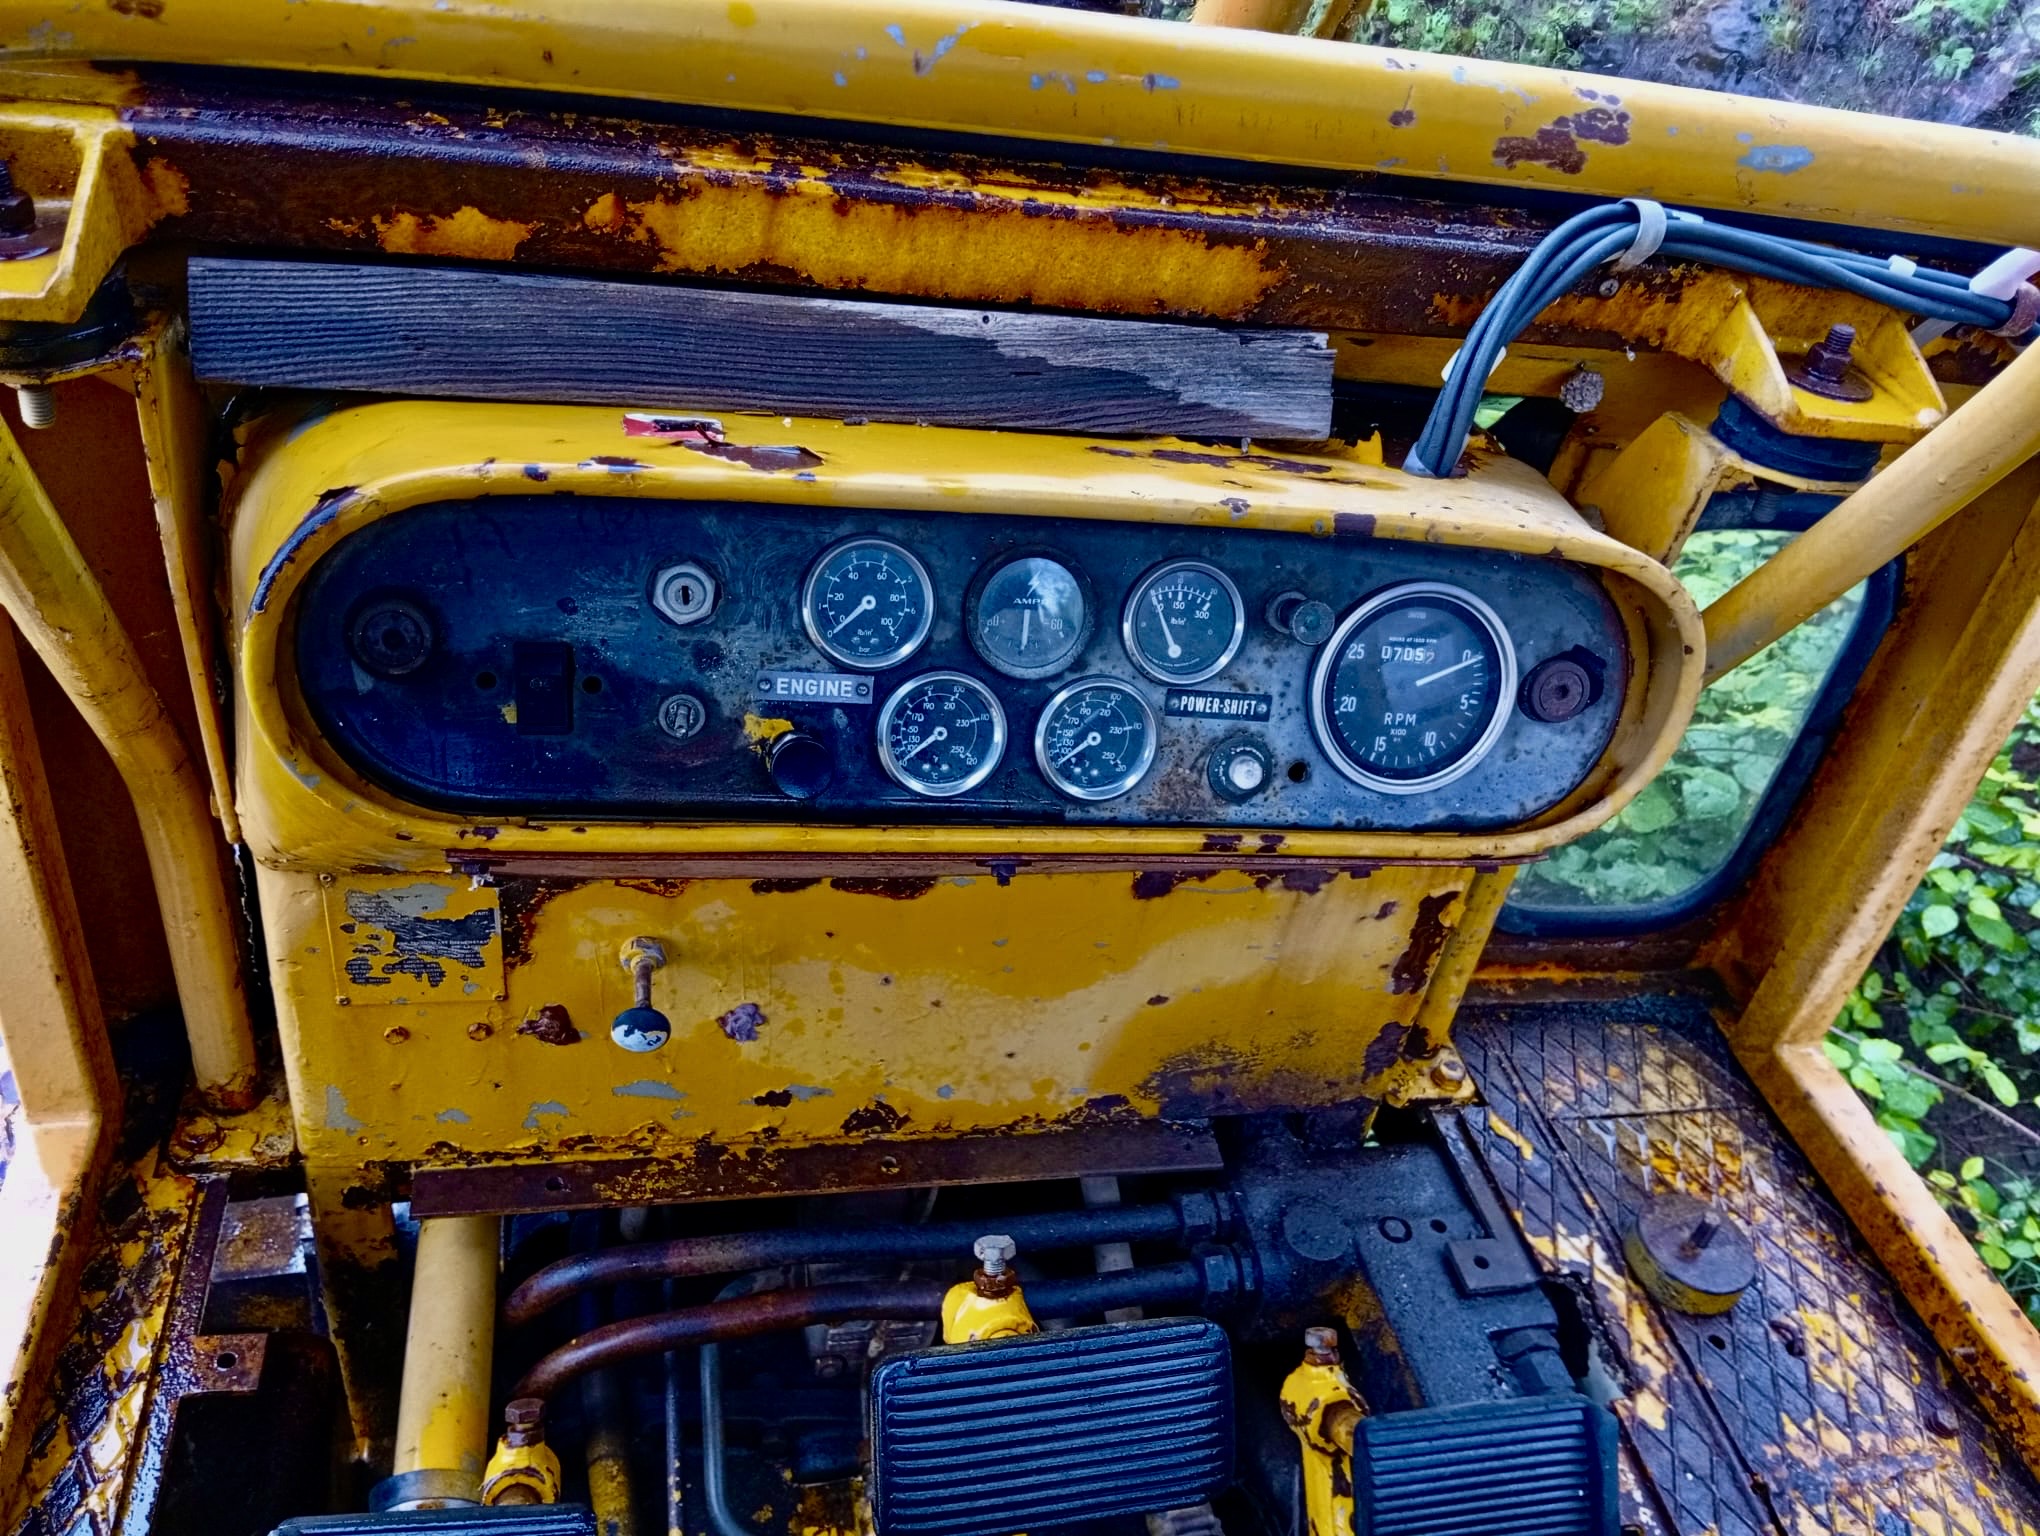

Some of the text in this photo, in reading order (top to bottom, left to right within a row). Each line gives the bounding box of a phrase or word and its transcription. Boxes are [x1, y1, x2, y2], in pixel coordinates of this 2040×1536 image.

[848, 572, 859, 580] 40
[876, 572, 888, 580] 60
[834, 592, 845, 601] 20
[1173, 601, 1186, 610] 150
[1194, 610, 1210, 620] 300
[880, 617, 893, 626] 100
[1050, 618, 1064, 630] 60
[1349, 643, 1365, 660] 25
[776, 677, 853, 698] ENGINE
[1339, 695, 1357, 713] 20
[1459, 694, 1470, 710] 5
[1384, 712, 1417, 727] RPM
[1062, 729, 1074, 737] 150
[1374, 736, 1387, 752] 15
[1424, 731, 1437, 747] 10
[950, 745, 964, 753] 250
[1101, 751, 1116, 760] 250
